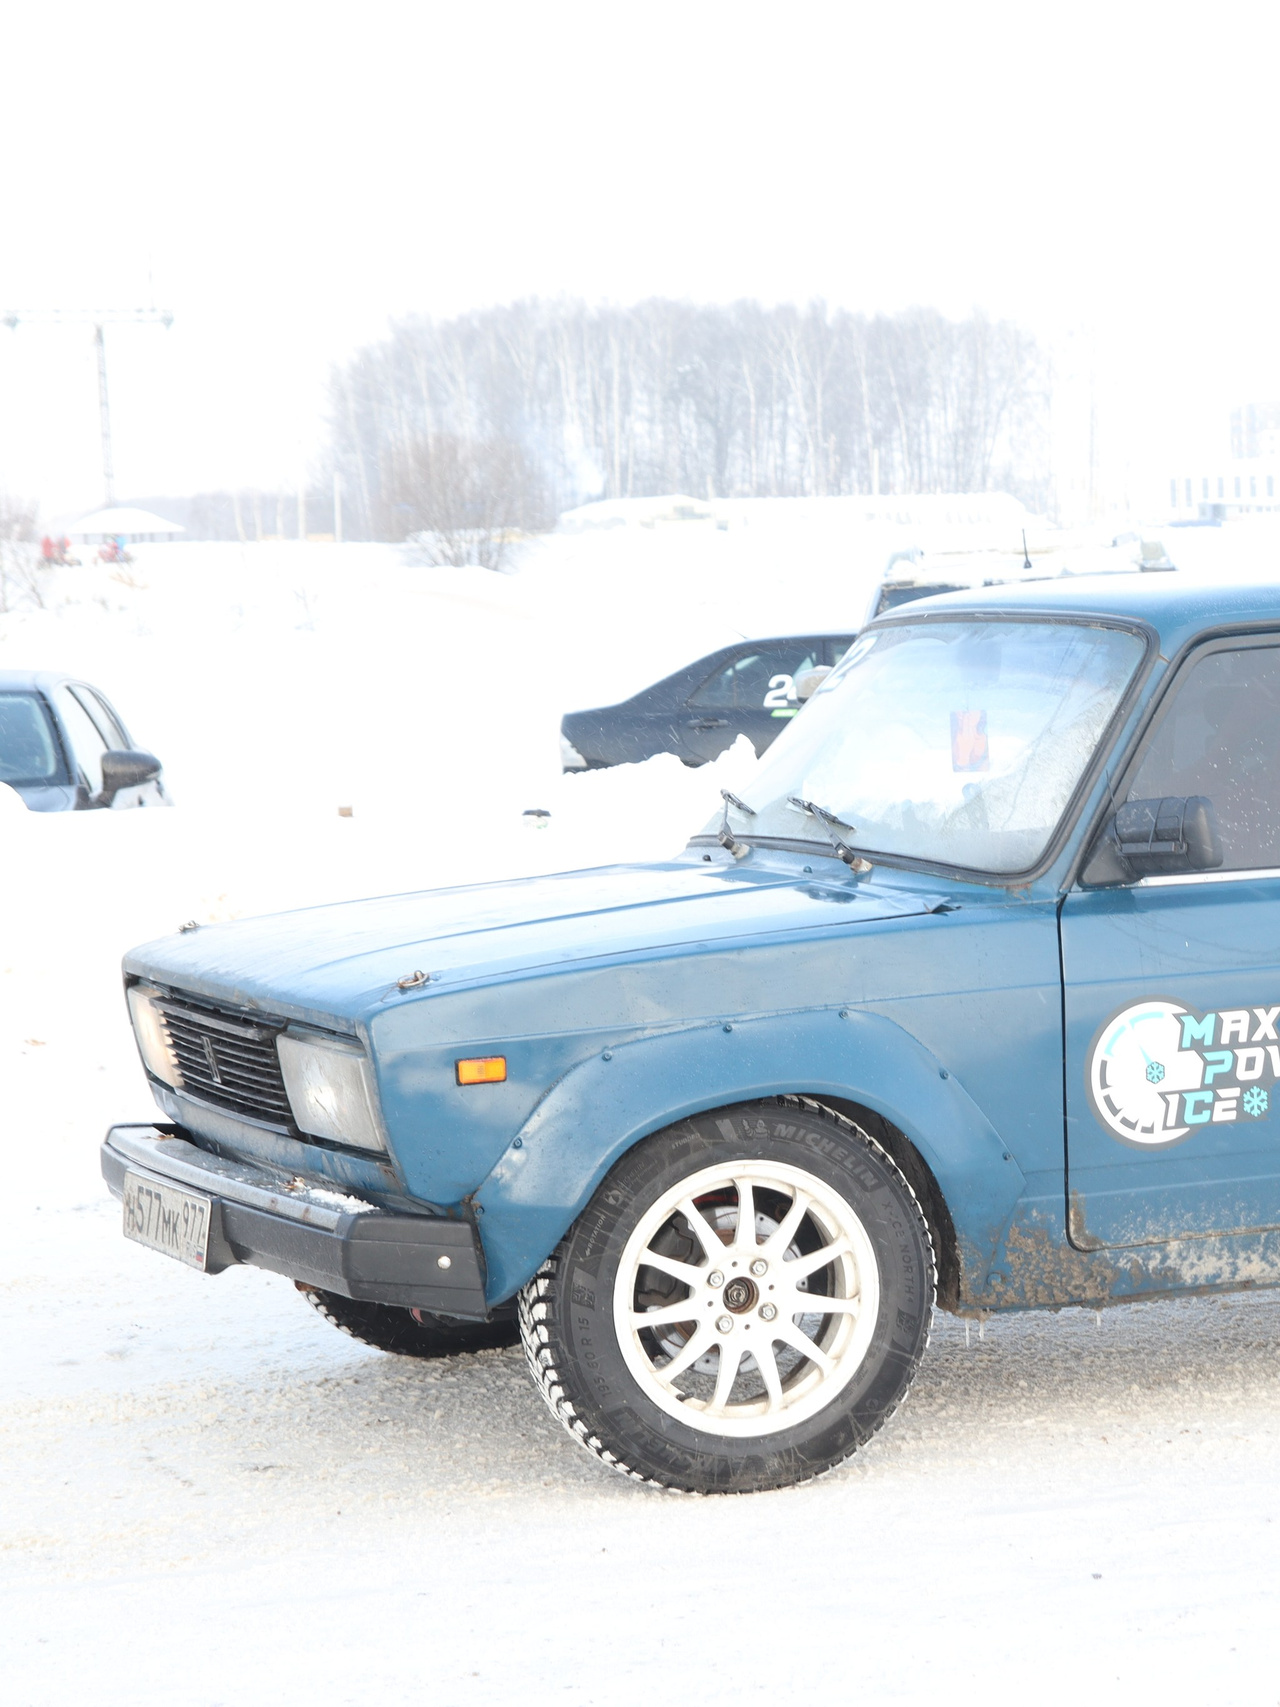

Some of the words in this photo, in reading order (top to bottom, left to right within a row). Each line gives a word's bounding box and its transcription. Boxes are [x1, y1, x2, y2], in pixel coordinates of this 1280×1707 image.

[1163, 1087, 1242, 1127] ICE
[772, 1122, 880, 1189] MICHELIN
[183, 1200, 206, 1245] 977
[578, 1316, 590, 1332] 15
[581, 1337, 593, 1347] R
